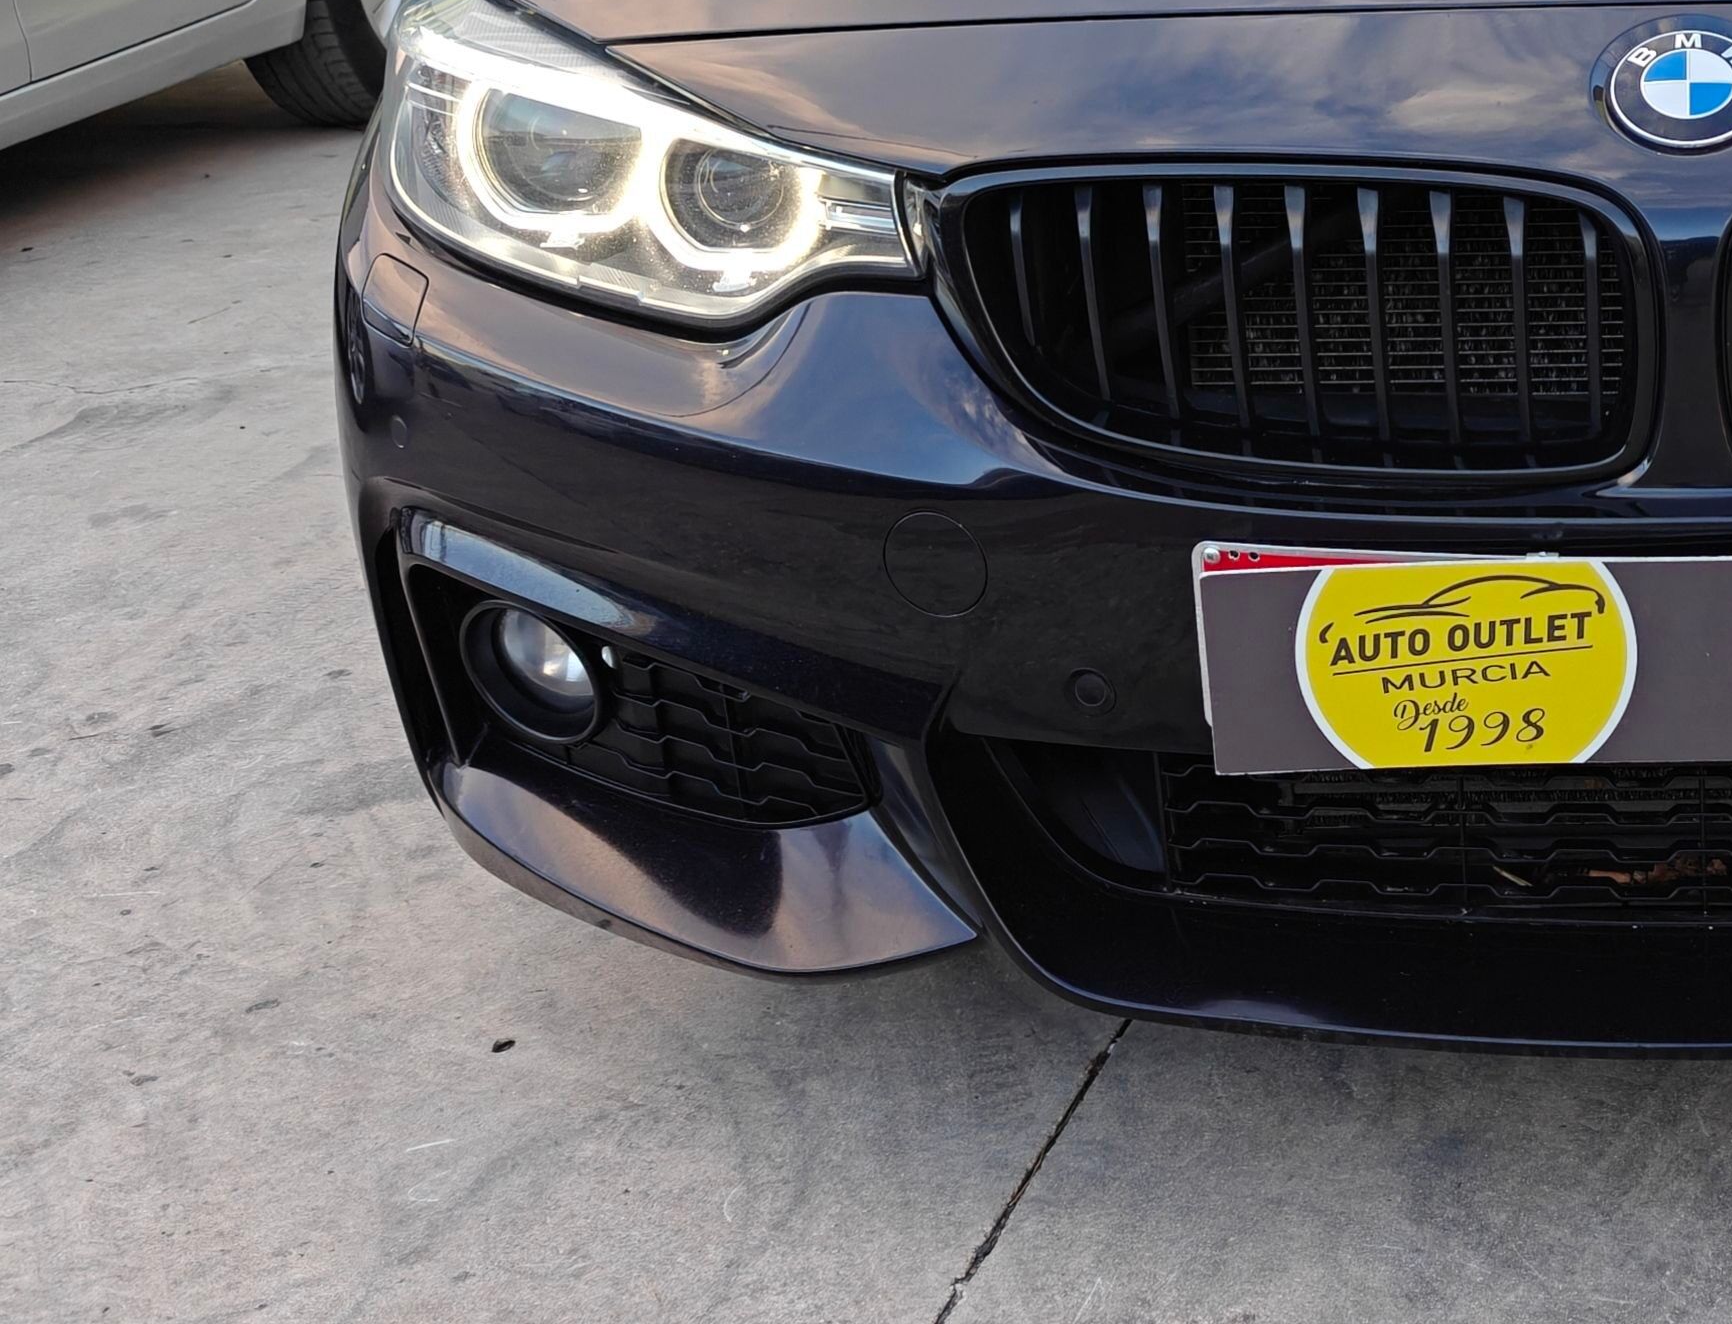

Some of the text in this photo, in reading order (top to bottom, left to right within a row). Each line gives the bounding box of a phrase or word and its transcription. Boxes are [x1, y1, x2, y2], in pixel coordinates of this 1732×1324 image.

[1330, 611, 1593, 667] AUTO OUTLET
[1381, 660, 1551, 694] MURCIA
[1393, 692, 1469, 731] Desde
[1419, 708, 1546, 753] 1998
